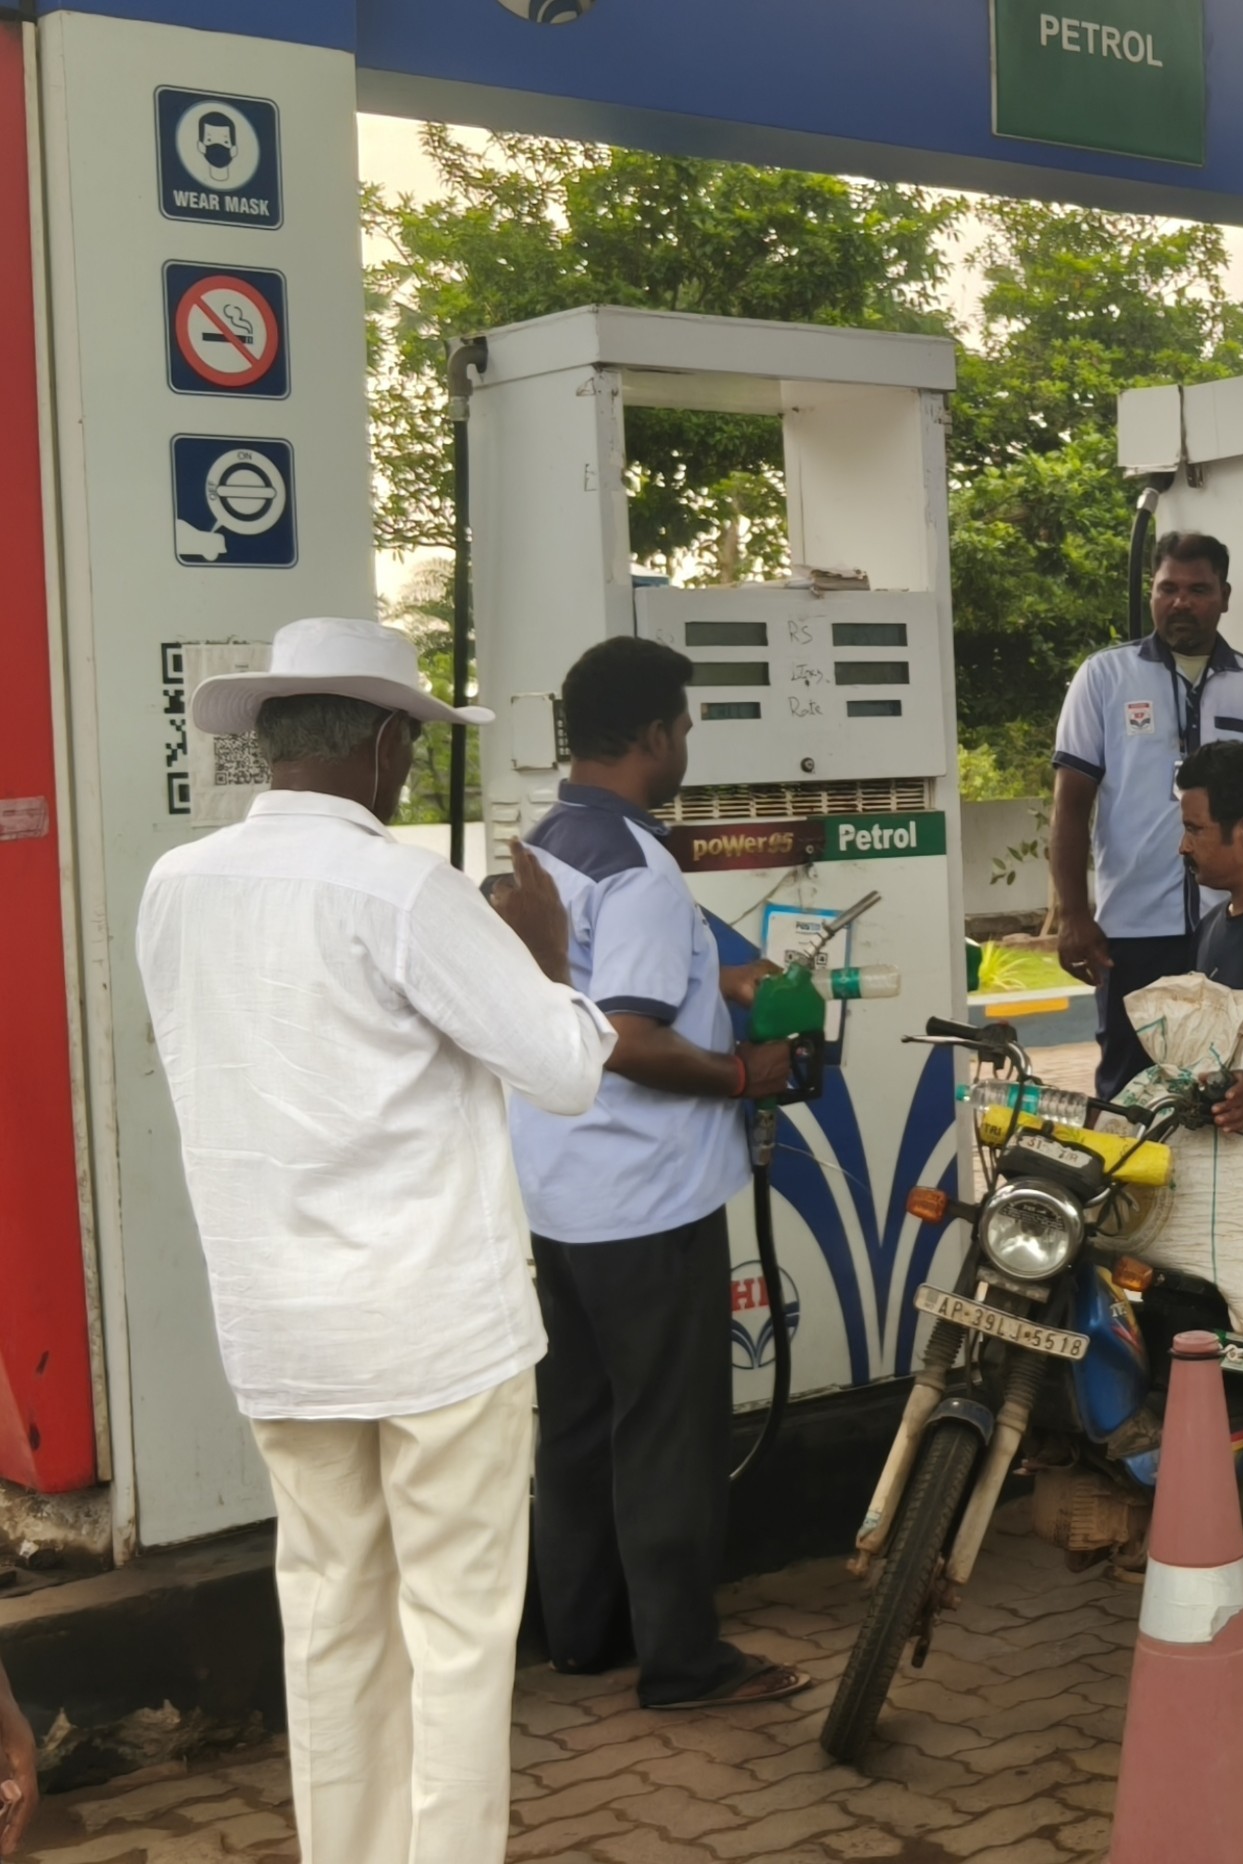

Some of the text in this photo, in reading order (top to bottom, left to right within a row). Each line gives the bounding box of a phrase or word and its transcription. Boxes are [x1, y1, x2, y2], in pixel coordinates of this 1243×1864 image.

[1040, 13, 1163, 67] PETROL
[173, 190, 270, 216] WEAR MASK
[237, 451, 252, 460] ON
[838, 820, 917, 851] Petrol
